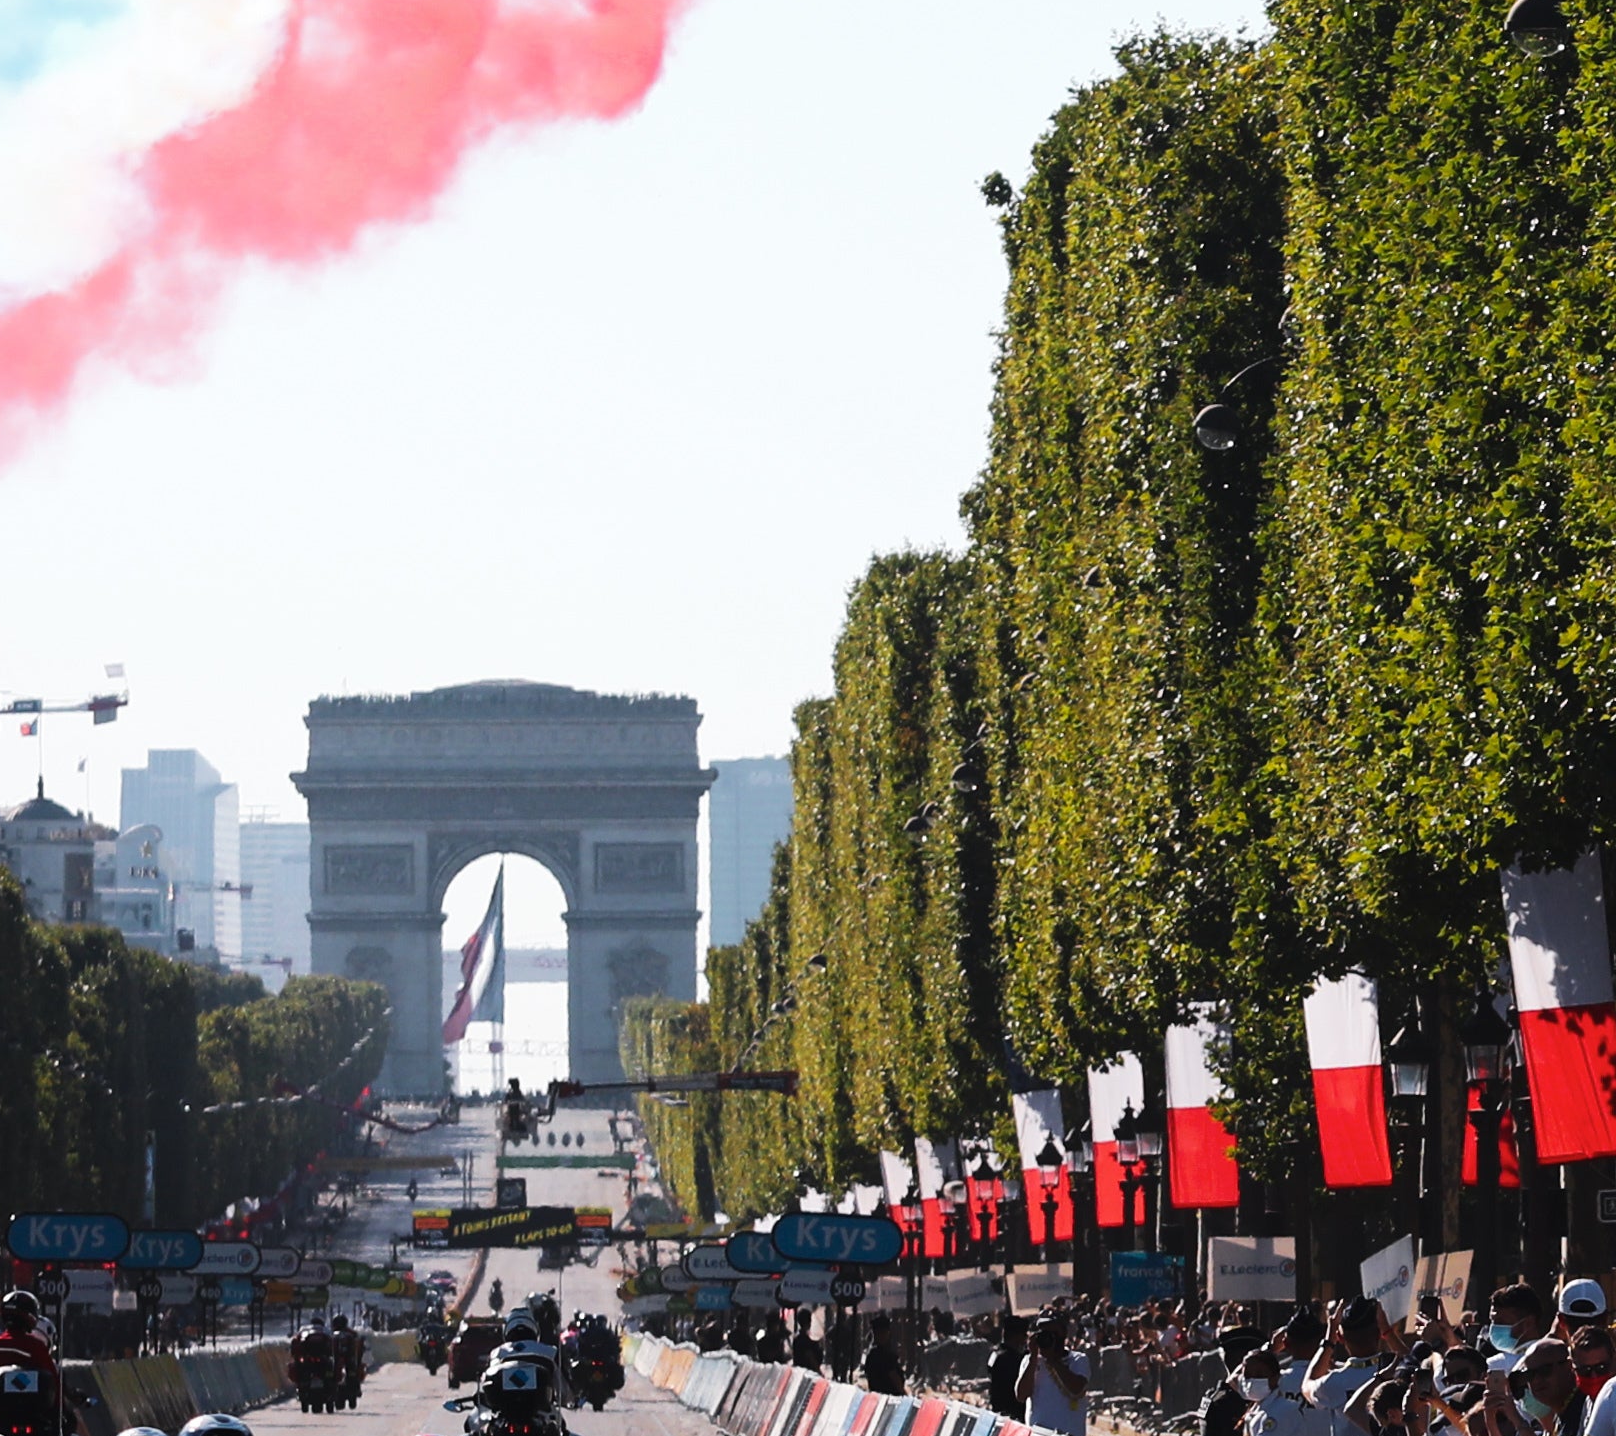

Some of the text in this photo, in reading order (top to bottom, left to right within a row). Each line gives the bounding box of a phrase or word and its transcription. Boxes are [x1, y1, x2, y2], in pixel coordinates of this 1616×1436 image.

[28, 1217, 105, 1257] Krys
[796, 1216, 877, 1259] Krys
[129, 1233, 184, 1265] Krys
[1220, 1263, 1280, 1277] E.Leclerc
[39, 1280, 66, 1296] 500
[140, 1285, 159, 1298] 450
[834, 1281, 862, 1298] 500
